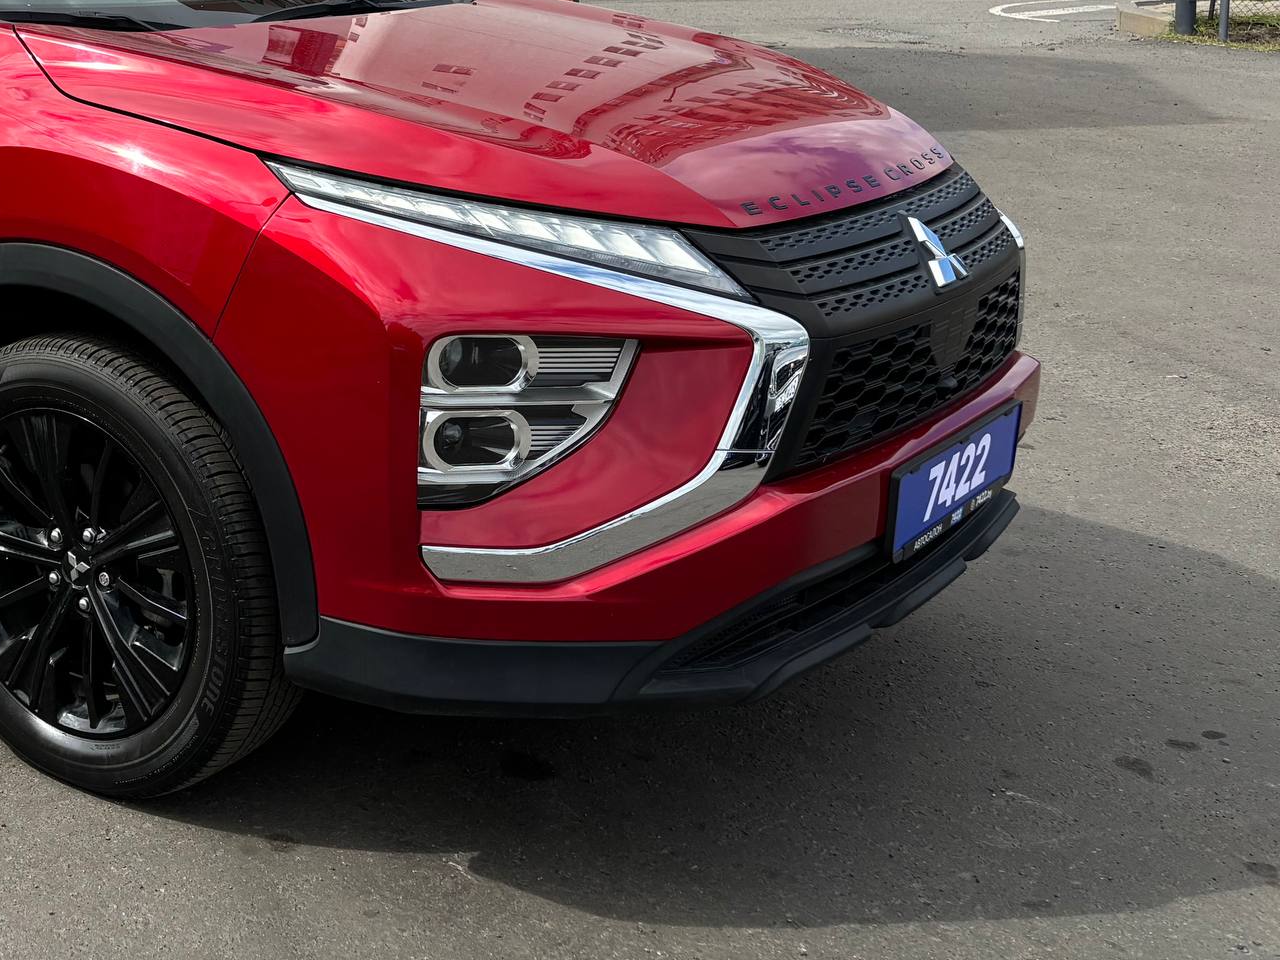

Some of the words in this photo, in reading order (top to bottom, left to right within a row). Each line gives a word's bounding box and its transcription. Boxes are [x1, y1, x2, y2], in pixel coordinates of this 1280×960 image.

[740, 174, 882, 217] ECLIPSE
[882, 146, 945, 183] CROSS
[923, 433, 992, 523] 7422
[913, 523, 944, 551] АВТОСАЛОН
